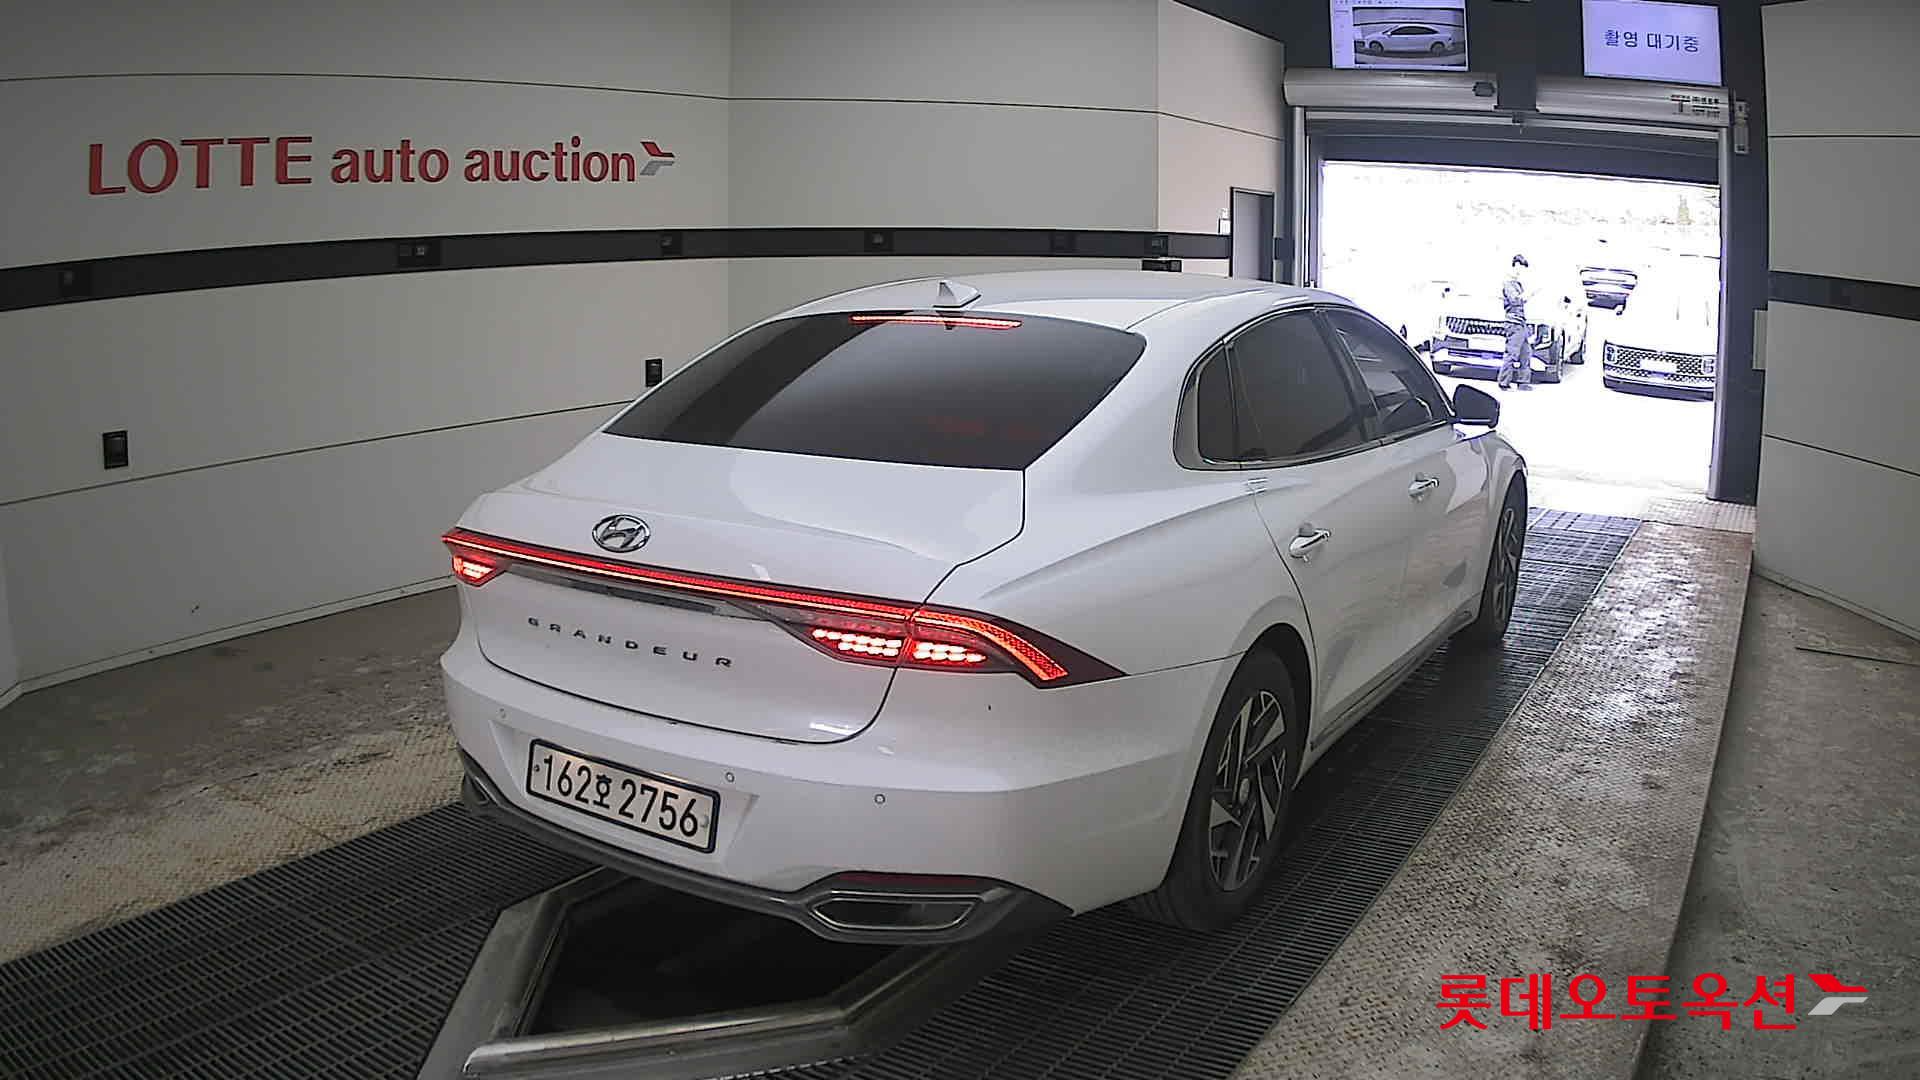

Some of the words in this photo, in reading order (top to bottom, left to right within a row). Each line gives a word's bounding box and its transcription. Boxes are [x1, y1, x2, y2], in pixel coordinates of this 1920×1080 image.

[1604, 29, 1638, 47] 촬영
[1646, 32, 1699, 53] 대기중
[88, 136, 313, 195] LOTTE
[330, 139, 449, 184] auto
[464, 136, 637, 183] auction
[527, 616, 733, 668] GRANDEUR
[618, 778, 699, 838] 2756
